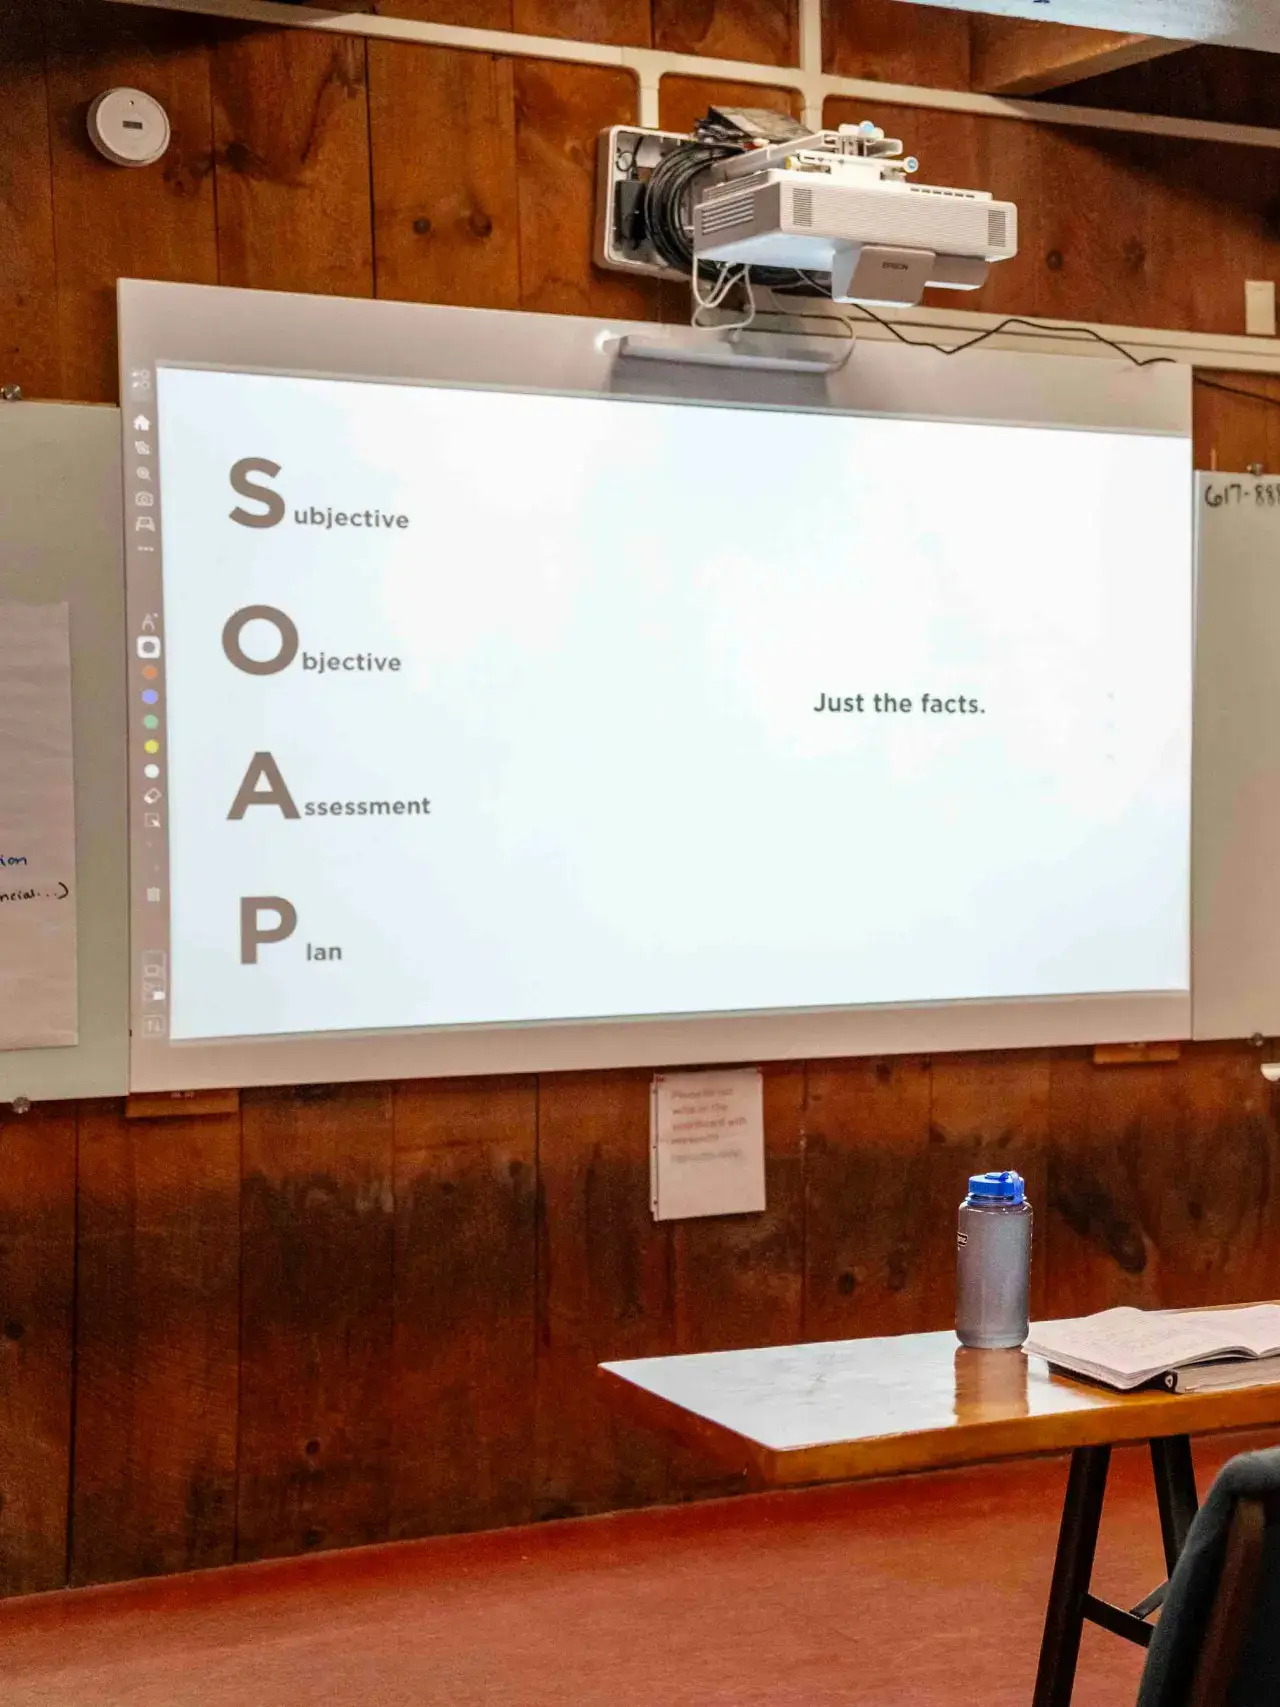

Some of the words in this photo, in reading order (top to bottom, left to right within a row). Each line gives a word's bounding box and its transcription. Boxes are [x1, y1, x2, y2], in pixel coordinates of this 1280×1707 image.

[813, 692, 865, 713] Just
[873, 692, 913, 713] the
[921, 692, 986, 714] facts.
